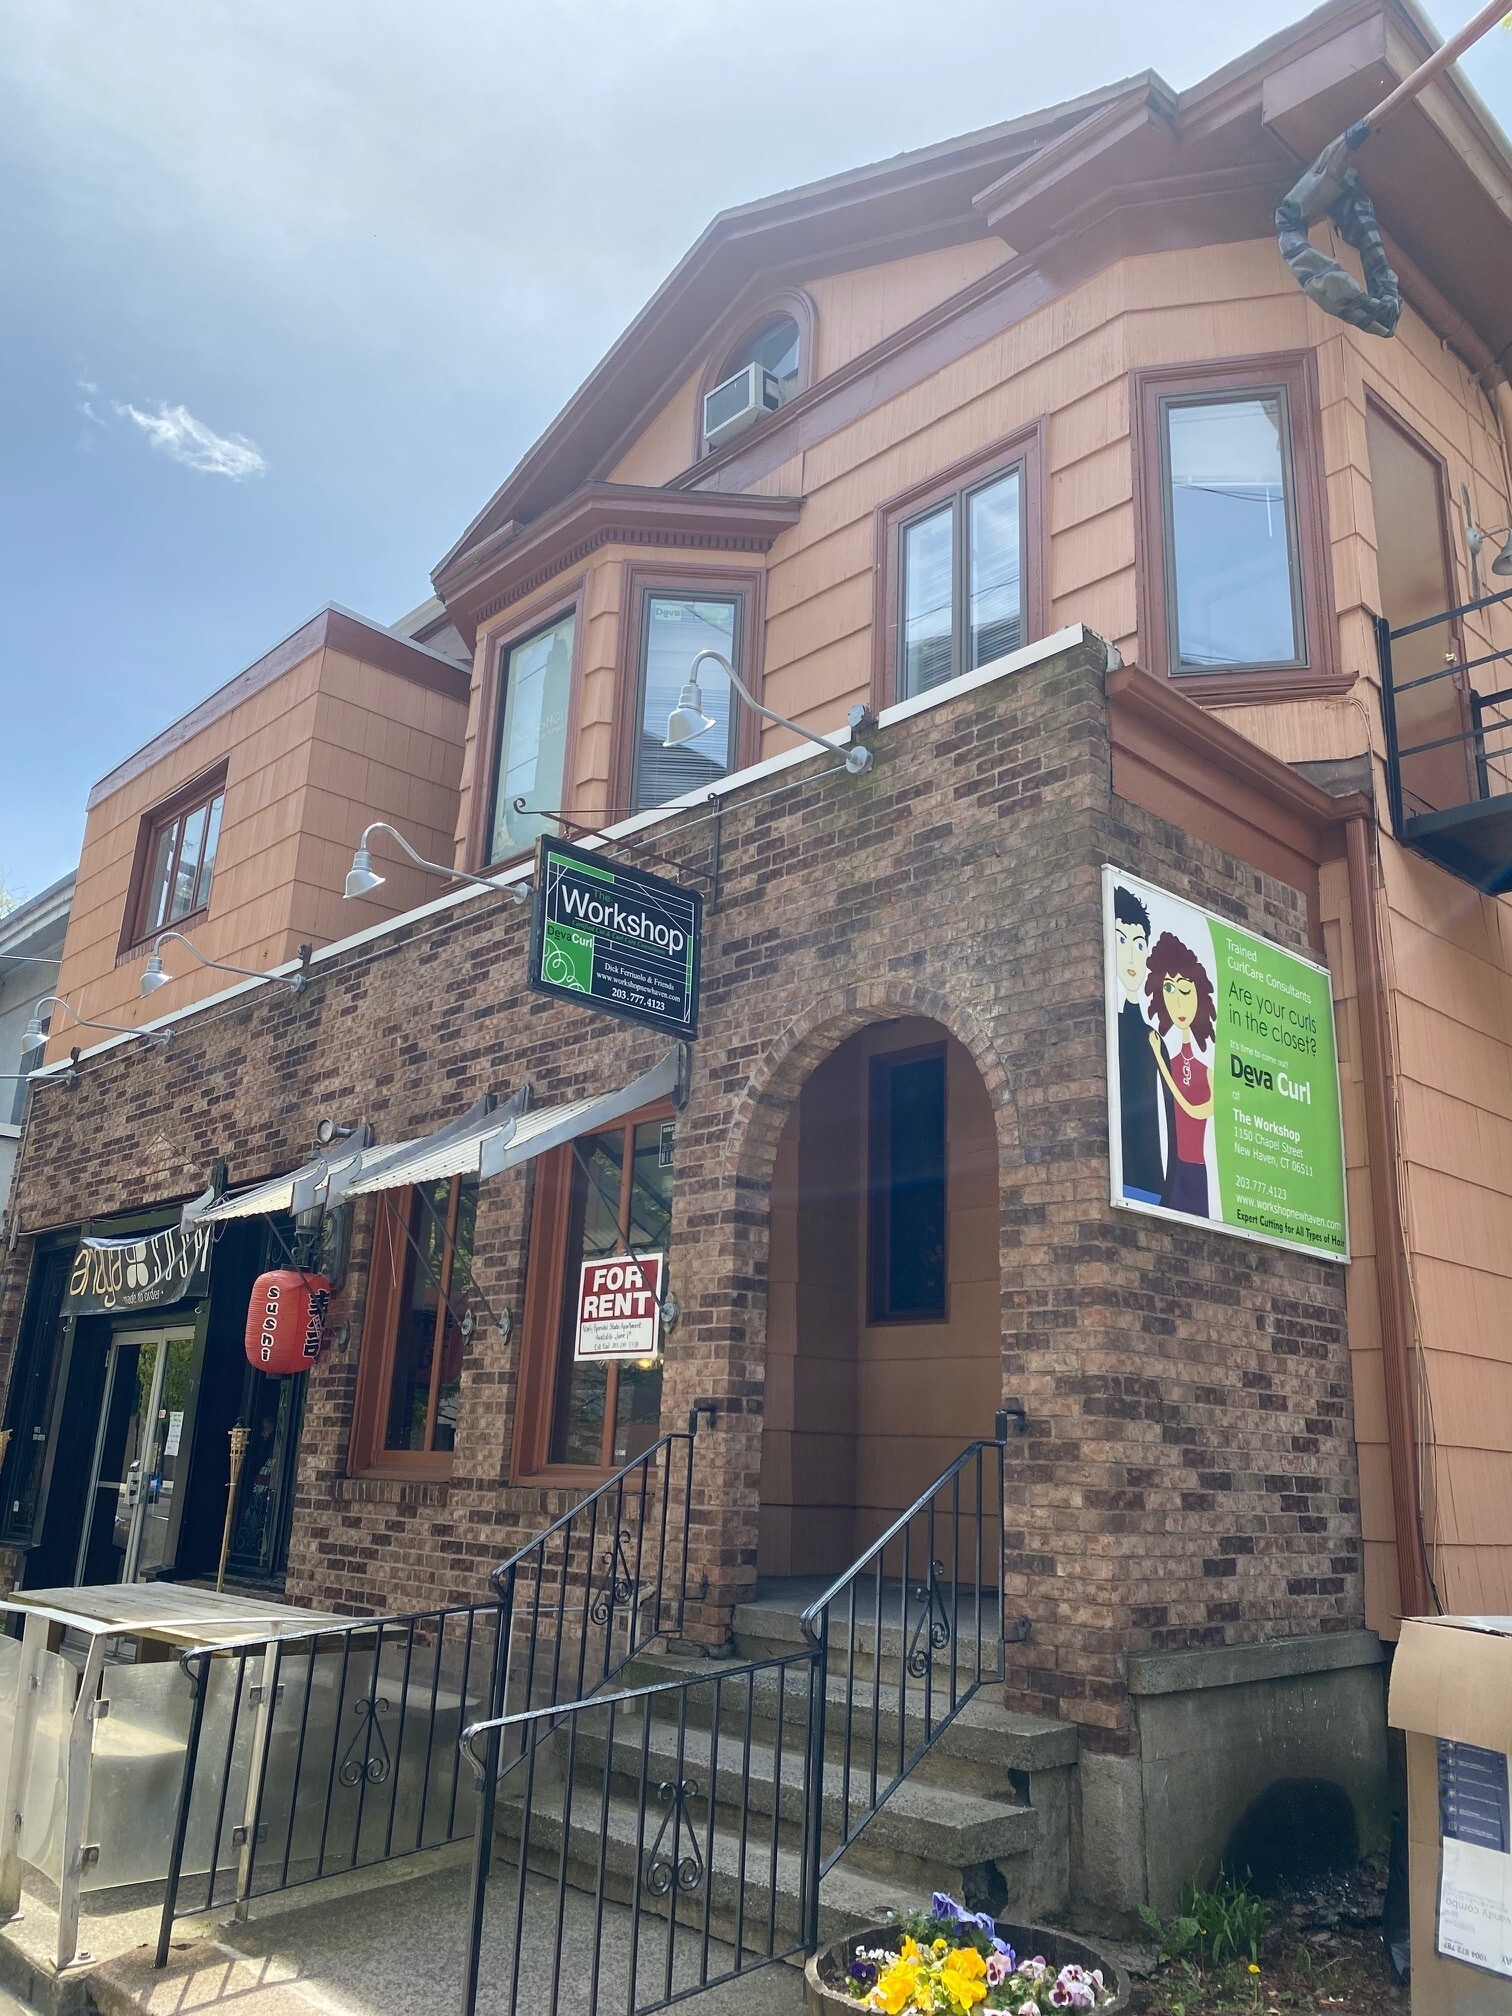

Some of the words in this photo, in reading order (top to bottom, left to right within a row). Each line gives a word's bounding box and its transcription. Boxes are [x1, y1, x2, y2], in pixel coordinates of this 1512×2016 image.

[593, 889, 610, 902] The
[562, 885, 684, 955] Workshop
[1226, 938, 1257, 962] Trained
[596, 972, 681, 1003] www.workshopnewhaven.com
[605, 962, 619, 974] Dick
[646, 976, 653, 984] &
[654, 978, 675, 991] Friends
[1228, 957, 1264, 982] CurlCare
[1266, 974, 1311, 1004] Consultants
[612, 987, 666, 1011] 203.777.4123
[1229, 981, 1252, 1006] Are
[1256, 995, 1285, 1019] your
[1289, 1010, 1317, 1034] curls
[1229, 1003, 1241, 1027] in
[1245, 1011, 1267, 1037] the
[1272, 1025, 1317, 1057] closet?
[1230, 1039, 1239, 1051] It's
[1240, 1044, 1253, 1056] time
[1254, 1049, 1260, 1058] to
[1262, 1053, 1277, 1065] come
[1230, 1053, 1273, 1091] Deva
[1277, 1072, 1311, 1105] Curl
[1232, 1091, 1240, 1100] at
[1233, 1107, 1251, 1125] The
[1254, 1114, 1300, 1144] Workshop
[1234, 1126, 1253, 1142] 1150
[1255, 1133, 1279, 1150] Chapel
[1281, 1142, 1303, 1158] Street
[1234, 1142, 1251, 1157] New
[1253, 1148, 1278, 1168] Haven,
[1280, 1157, 1290, 1169] CT
[1292, 1160, 1313, 1177] 06511
[1235, 1175, 1287, 1200] 203.777.4123
[1236, 1194, 1341, 1231] www.workshopnewhaven.com
[1237, 1209, 1258, 1224] Expert
[1260, 1215, 1283, 1234] Cutting
[1285, 1222, 1294, 1234] for
[1295, 1226, 1304, 1236] All
[1305, 1227, 1322, 1242] Types
[1324, 1234, 1330, 1244] of
[1332, 1234, 1345, 1248] Hair
[593, 1265, 643, 1292] FOR
[138, 1292, 145, 1302] to
[144, 1288, 160, 1301] order
[583, 1291, 651, 1319] RENT
[260, 1285, 280, 1362] sushi
[1445, 1898, 1480, 1914] combo
[1482, 1907, 1512, 1924] vanity
